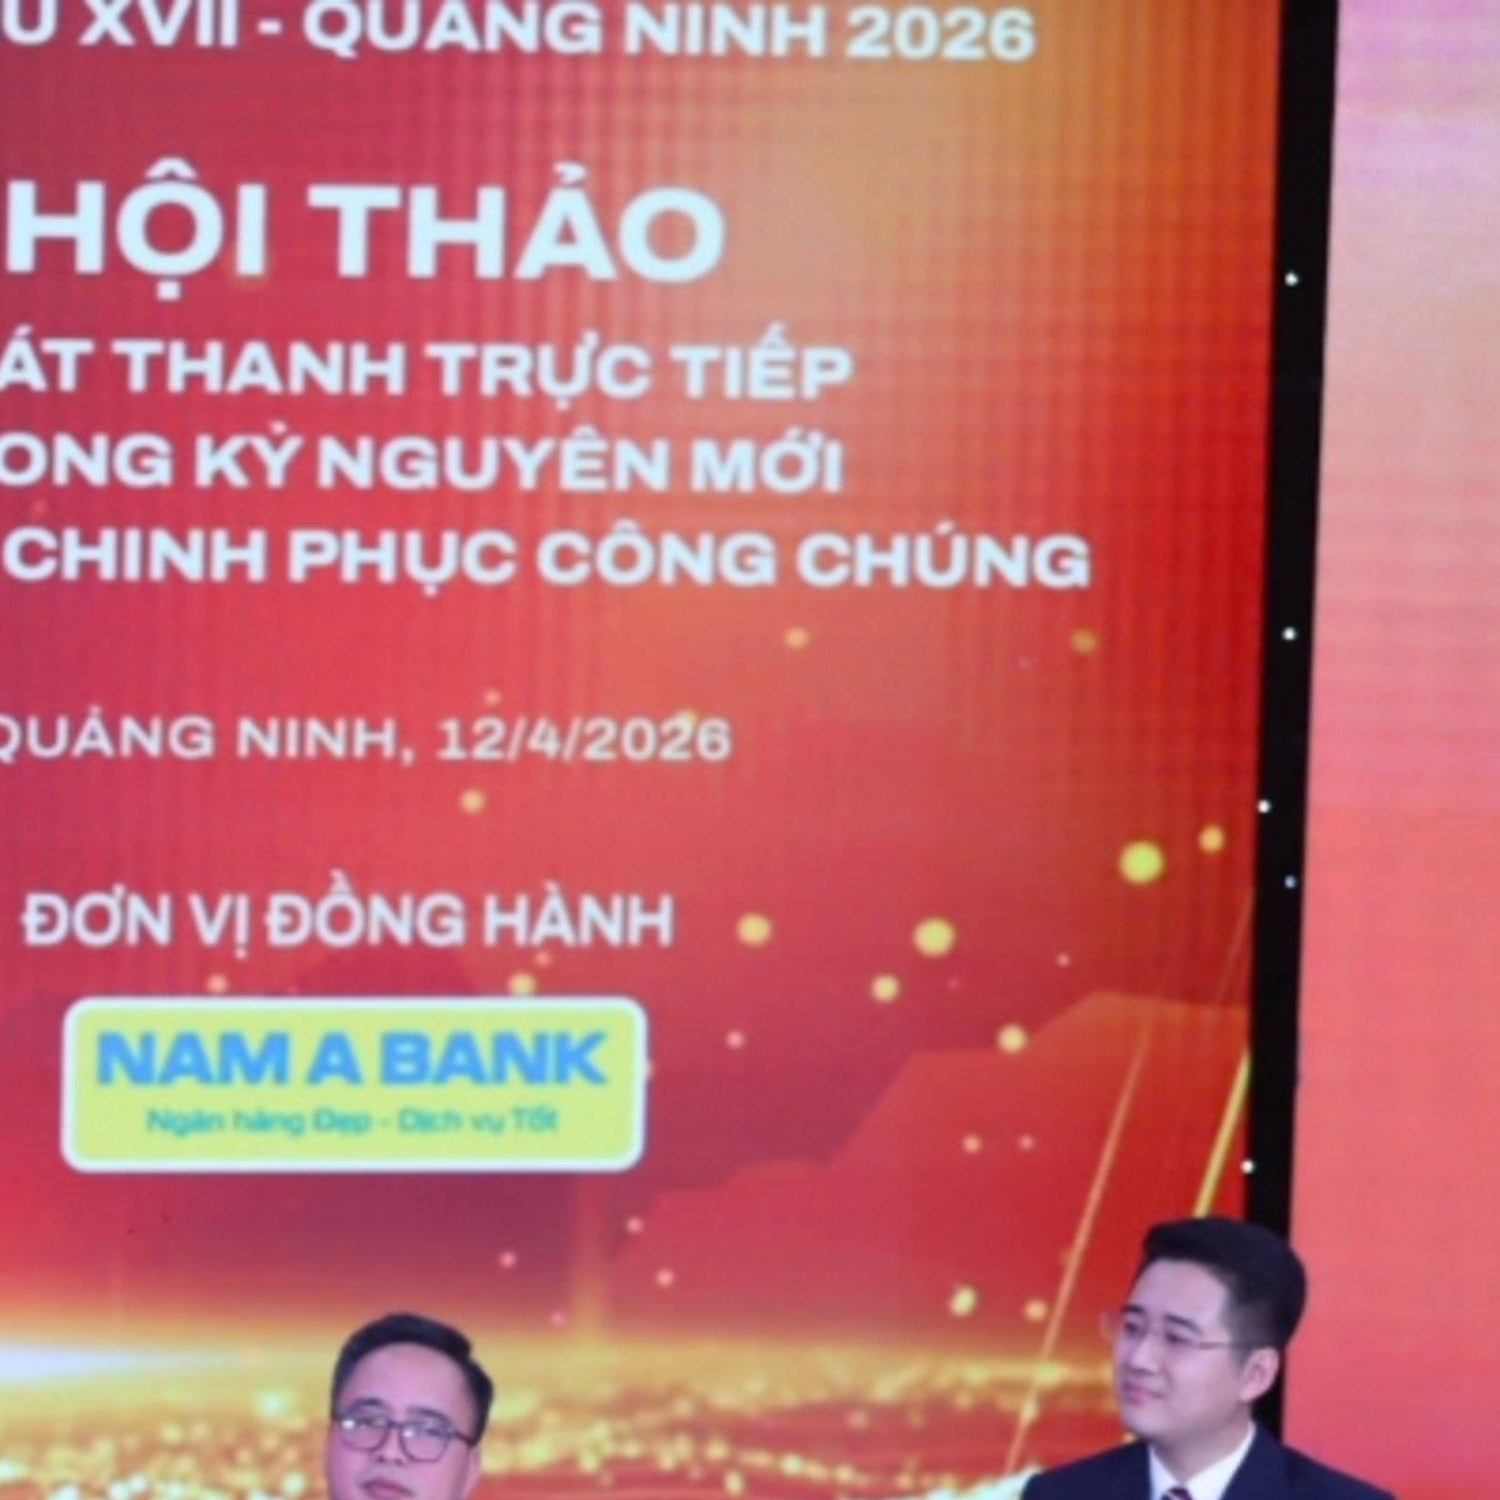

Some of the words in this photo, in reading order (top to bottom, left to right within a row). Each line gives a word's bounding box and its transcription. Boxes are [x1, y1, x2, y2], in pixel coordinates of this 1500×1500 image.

[258, 21, 281, 34] -
[623, 0, 828, 58] NINH
[845, 5, 1036, 61] 2026
[5, 157, 267, 300] HỘI
[307, 162, 727, 284] THẢO
[111, 339, 405, 395] THANH
[424, 330, 652, 410] TRỰC
[669, 322, 853, 401] TIẾP
[195, 421, 302, 487] KỶ
[317, 425, 671, 493] NGUYÊN
[690, 428, 843, 494] MỚI
[2, 527, 267, 582] CHINH
[288, 530, 516, 596] PHỤC
[536, 519, 777, 587] CÔNG
[796, 521, 1090, 588] CHÚNG
[237, 718, 415, 767] NINH,
[438, 716, 732, 763] 12/4/2026
[21, 885, 172, 947] ĐƠN
[189, 894, 249, 960] VỊ
[265, 869, 466, 947] ĐỒNG
[483, 883, 674, 947] HÀNH
[95, 1030, 292, 1087] NAM
[306, 1031, 364, 1087] A
[379, 1031, 607, 1087] BANK
[146, 1107, 224, 1137] Ngân
[232, 1107, 306, 1138] hàng
